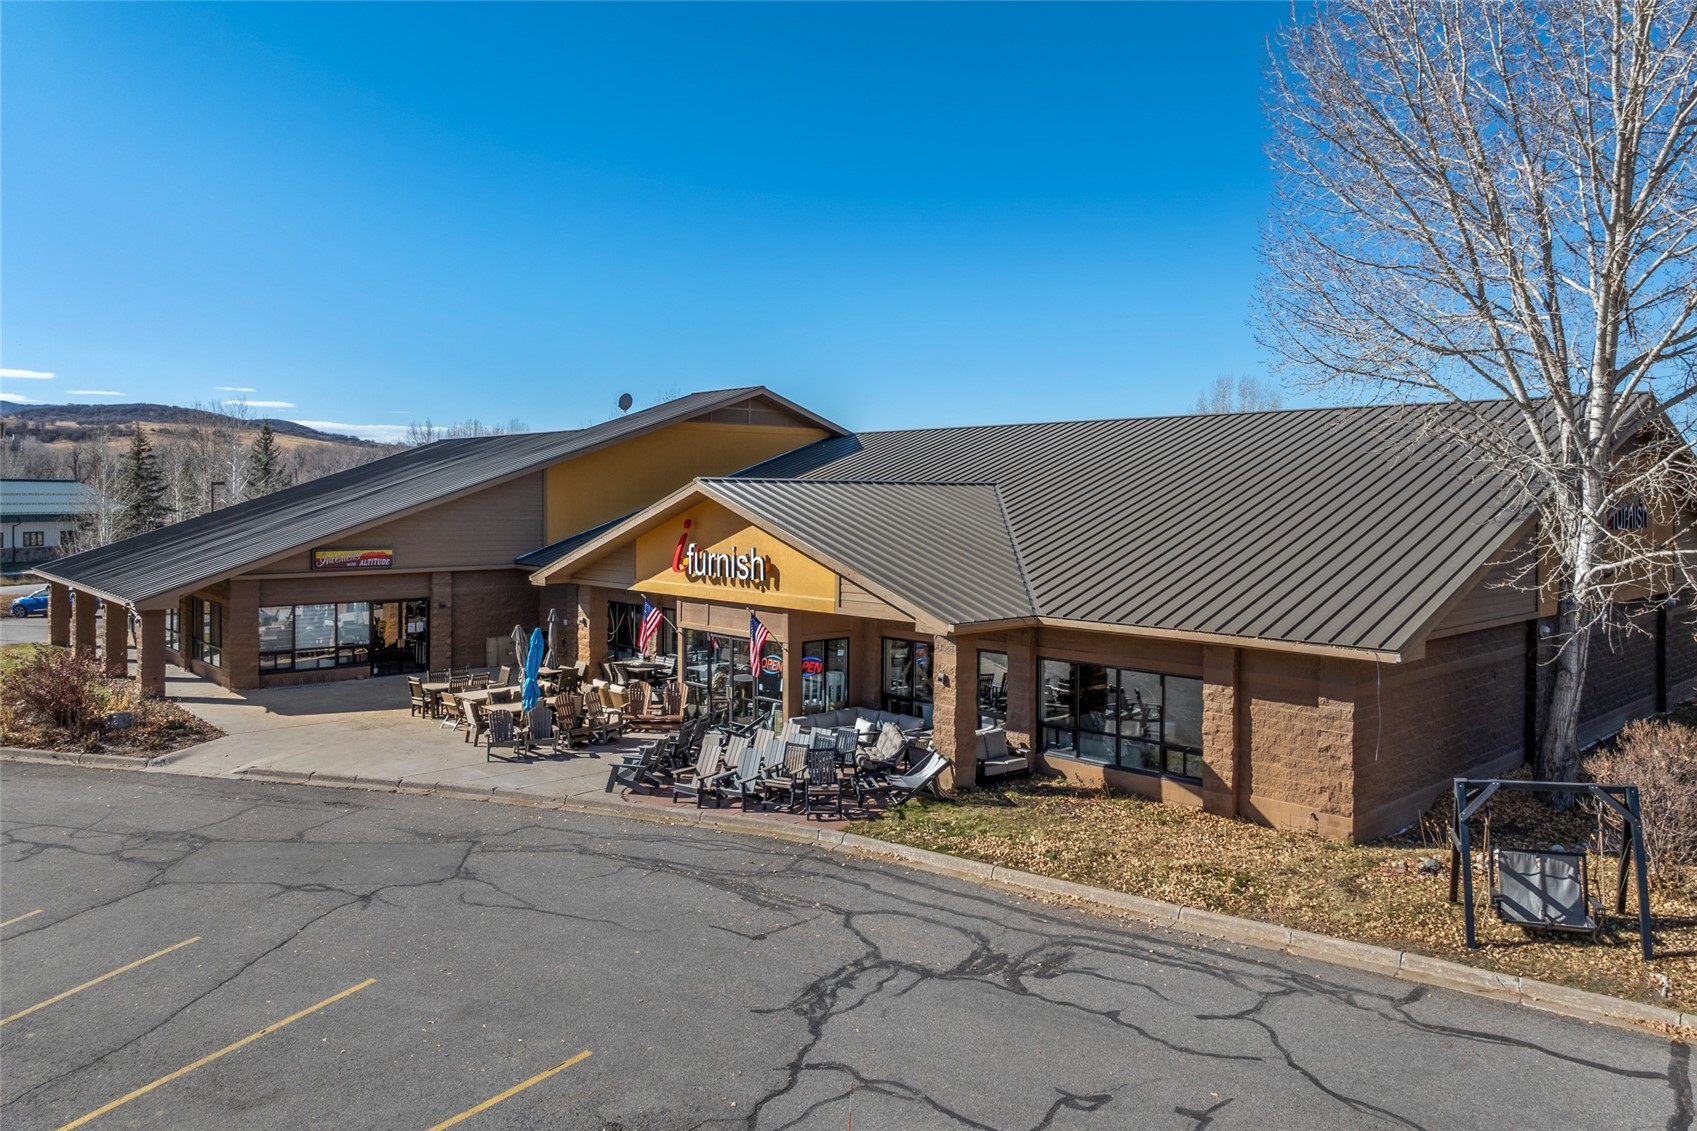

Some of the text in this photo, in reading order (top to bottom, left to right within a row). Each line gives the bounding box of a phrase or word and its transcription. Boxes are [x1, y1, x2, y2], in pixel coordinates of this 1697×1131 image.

[359, 557, 391, 566] ALTITUDE
[686, 542, 764, 581] furnish
[802, 661, 824, 673] PEN
